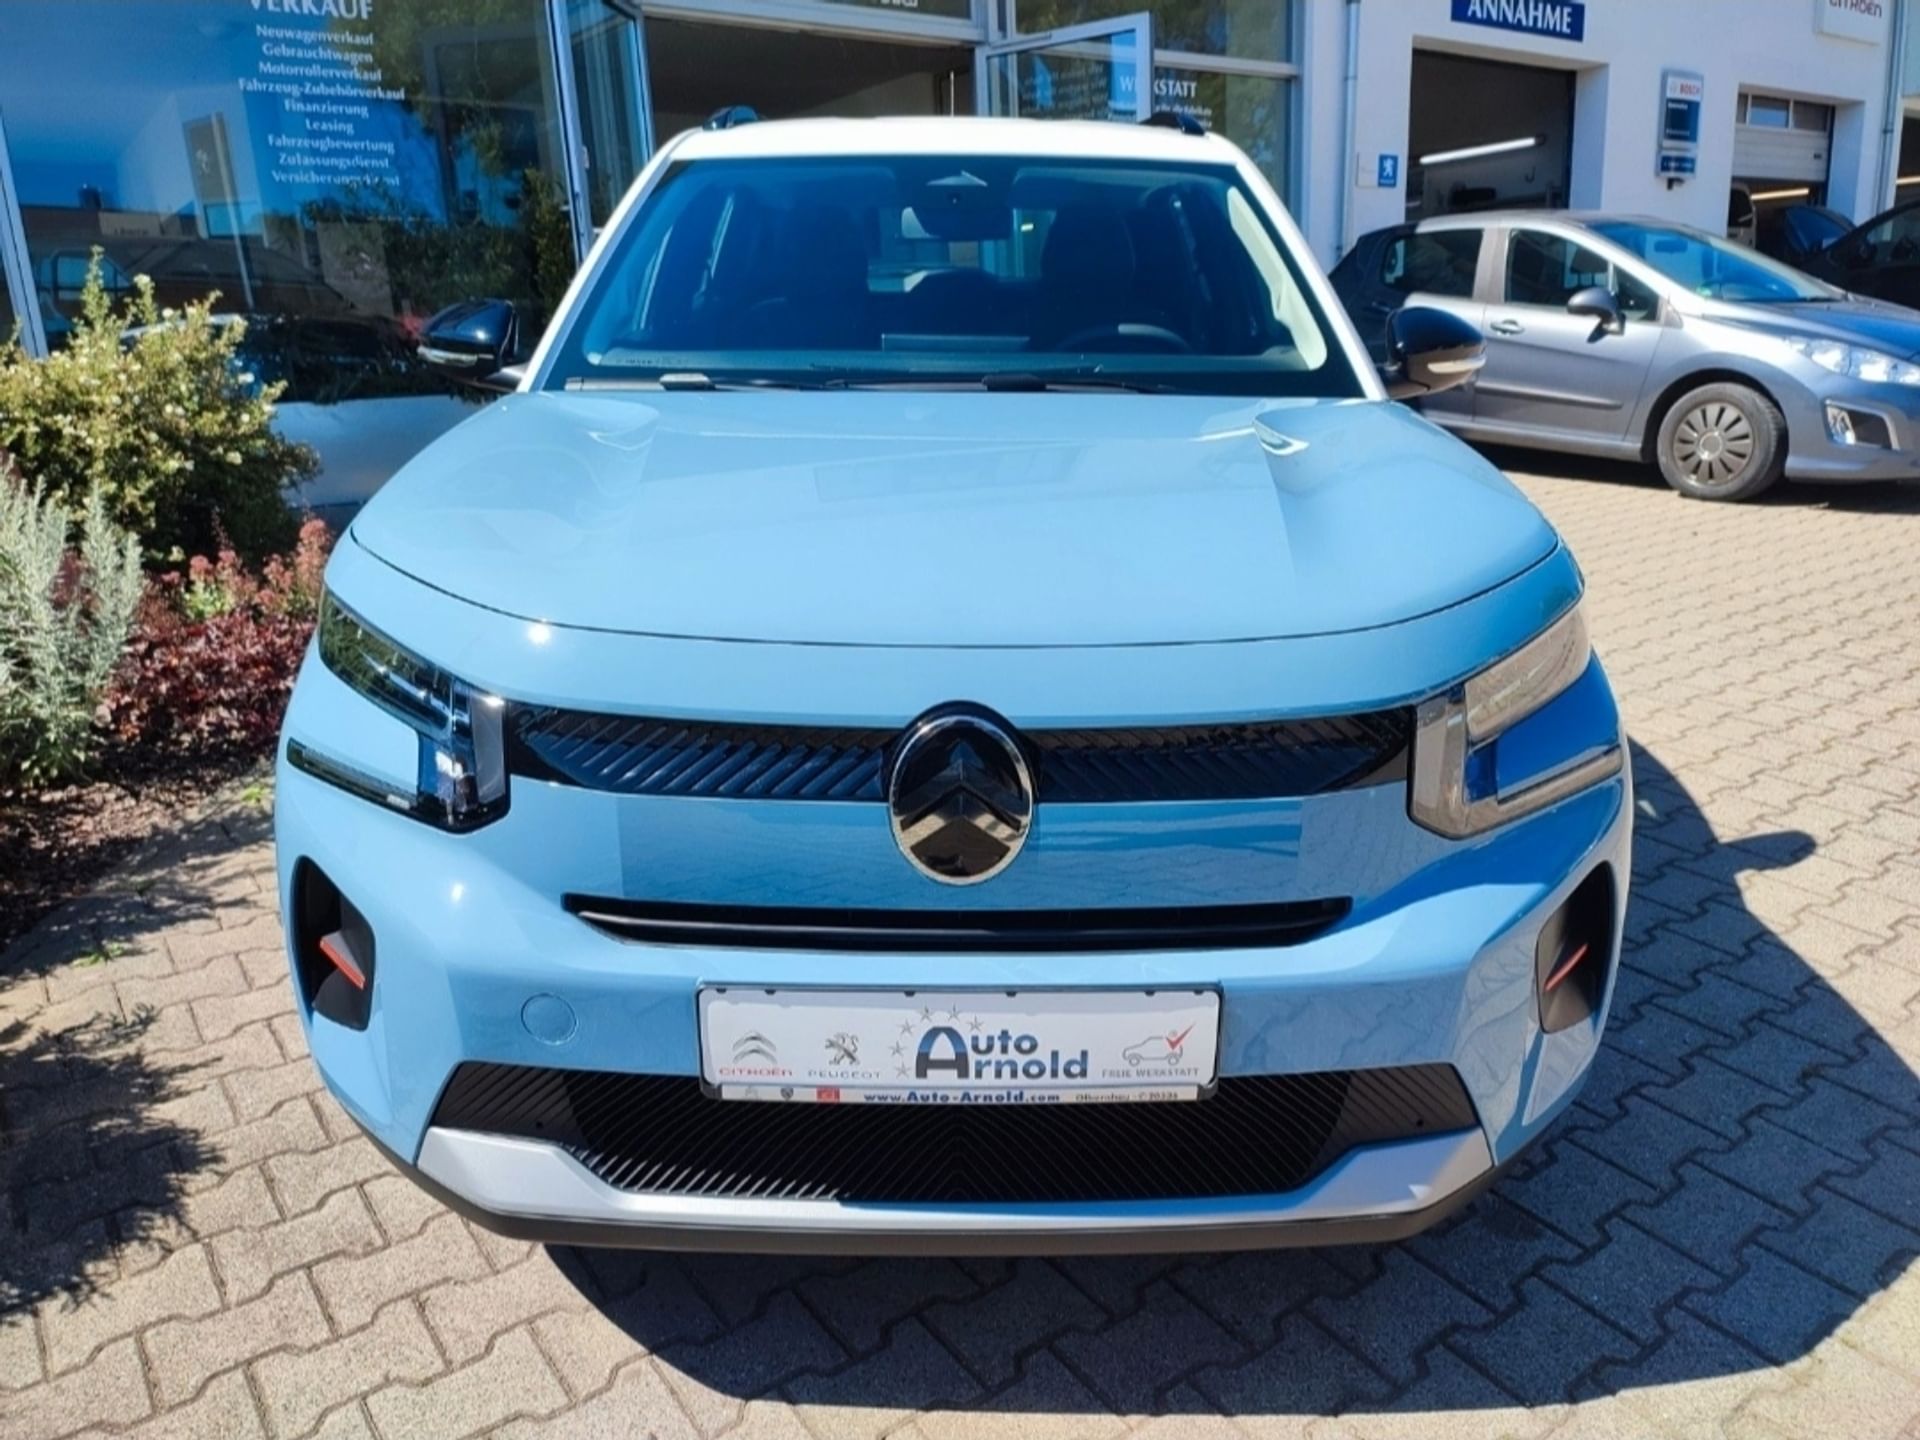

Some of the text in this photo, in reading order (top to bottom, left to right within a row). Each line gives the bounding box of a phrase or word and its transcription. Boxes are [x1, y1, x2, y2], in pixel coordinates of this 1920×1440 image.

[1467, 0, 1572, 34] ANNAHME
[256, 24, 374, 46] Neuwagenverkauf
[262, 42, 374, 64] Gebrauchtwagen
[258, 61, 382, 82] Motorrollerverkauf
[238, 78, 405, 101] Fahrzeug-Zubehörverkauf
[284, 99, 369, 119] Finanzierung
[305, 118, 355, 136] Leasing
[268, 134, 395, 155] Fahrzeugbewertung
[279, 153, 390, 170] Zulassungsdienst
[916, 1026, 1039, 1070] Auto
[916, 1036, 1089, 1079] Arnold
[808, 1069, 881, 1080] PEUGEOT
[1136, 1067, 1200, 1078] WERKSTATT
[863, 1091, 1060, 1103] www.Auto-Arnold.com
